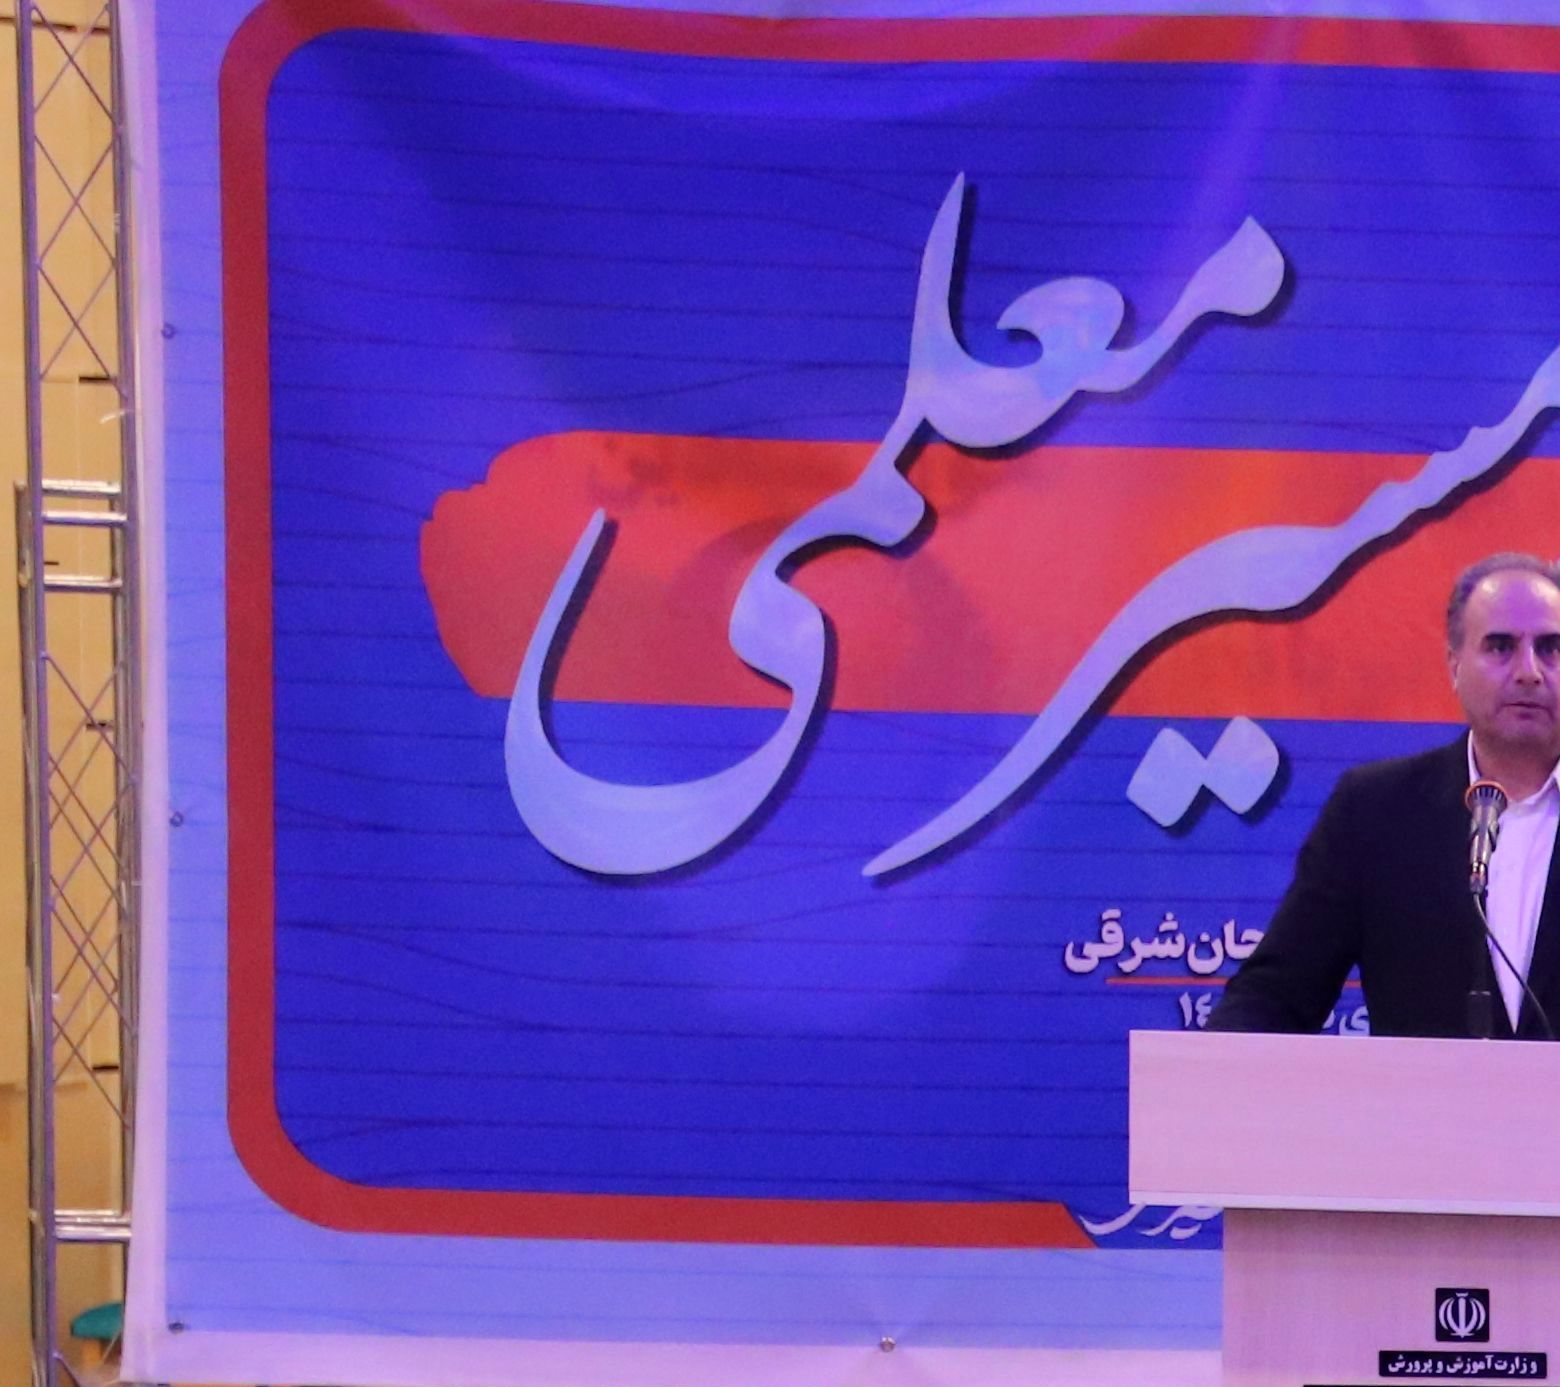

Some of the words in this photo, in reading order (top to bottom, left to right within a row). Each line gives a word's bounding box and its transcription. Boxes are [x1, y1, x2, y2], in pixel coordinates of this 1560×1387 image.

[504, 170, 1287, 876] معلمی
[1064, 907, 1186, 974] شرقی
[1388, 1354, 1433, 1374] پرورش
[1435, 1360, 1444, 1374] و
[1446, 1354, 1494, 1375] آموزش
